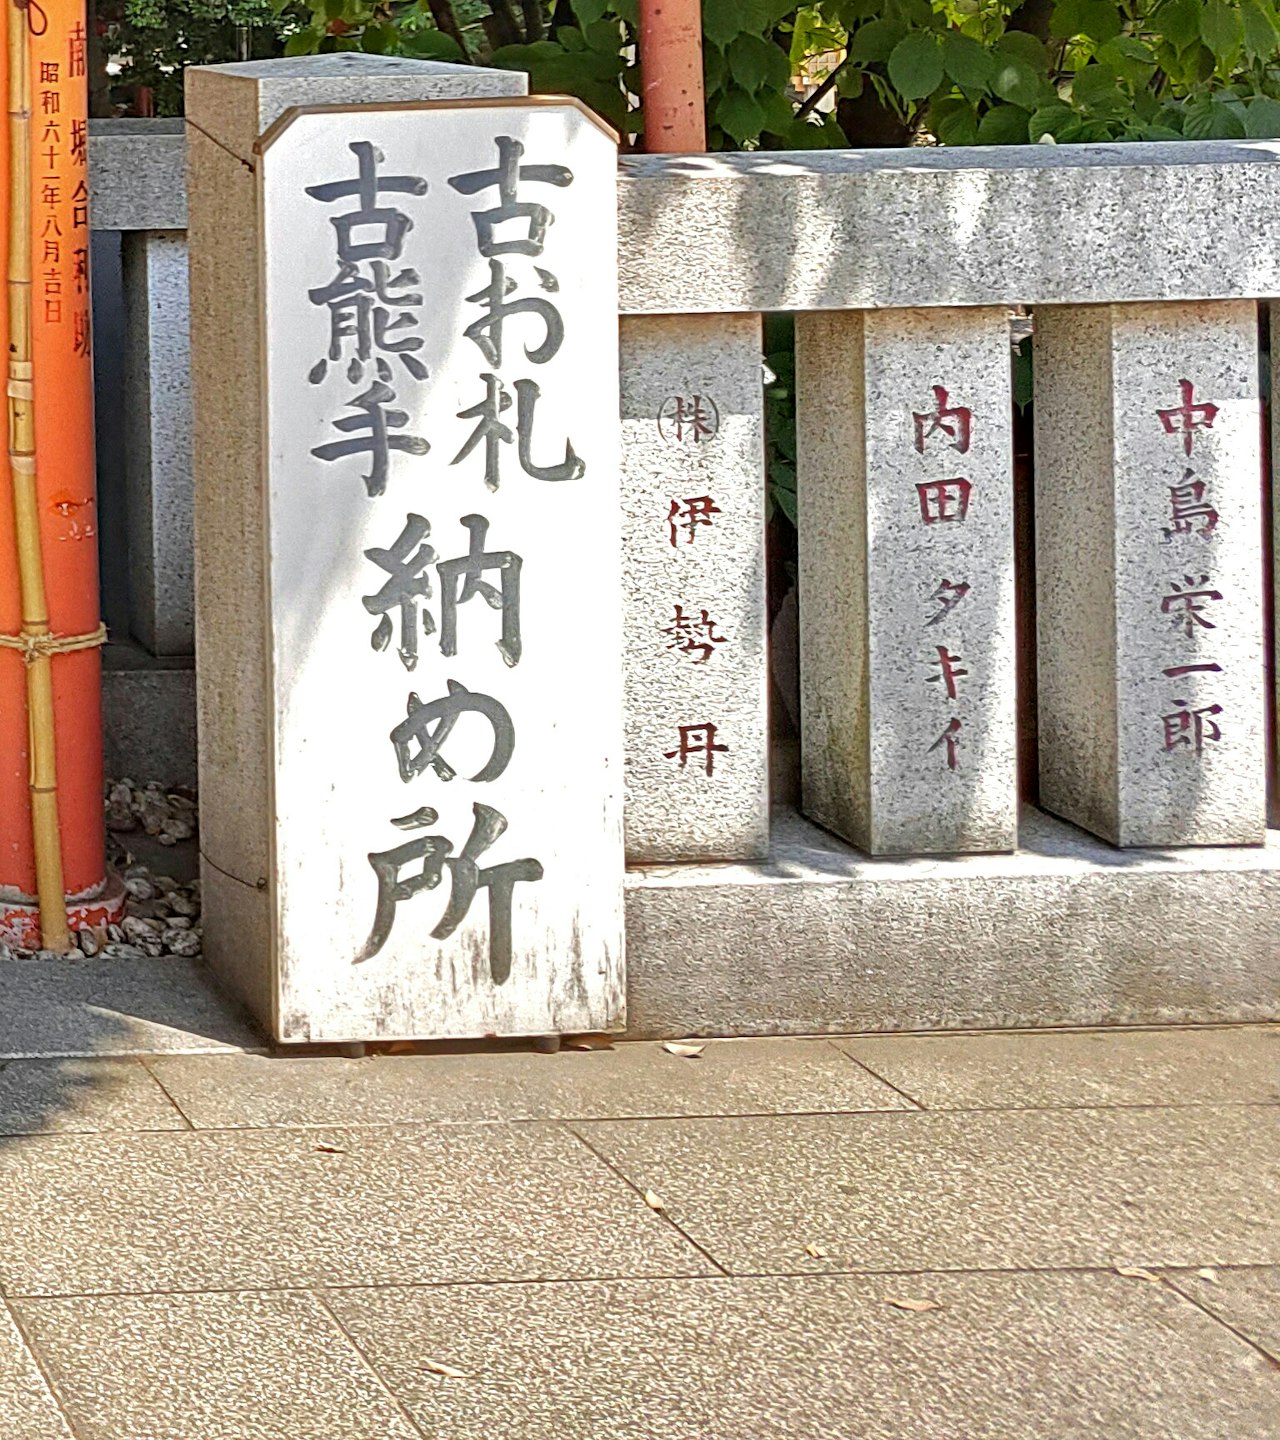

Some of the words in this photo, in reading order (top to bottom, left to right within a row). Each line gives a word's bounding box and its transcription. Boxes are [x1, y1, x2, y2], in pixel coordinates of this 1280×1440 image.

[39, 61, 63, 325] 昭和六十一年八月吉日
[304, 140, 431, 499] 古熊手
[447, 135, 586, 494] 古お札
[351, 512, 544, 986] 納め所
[912, 384, 974, 770] 内田タキイ
[1156, 378, 1224, 760] 中島栄一郎
